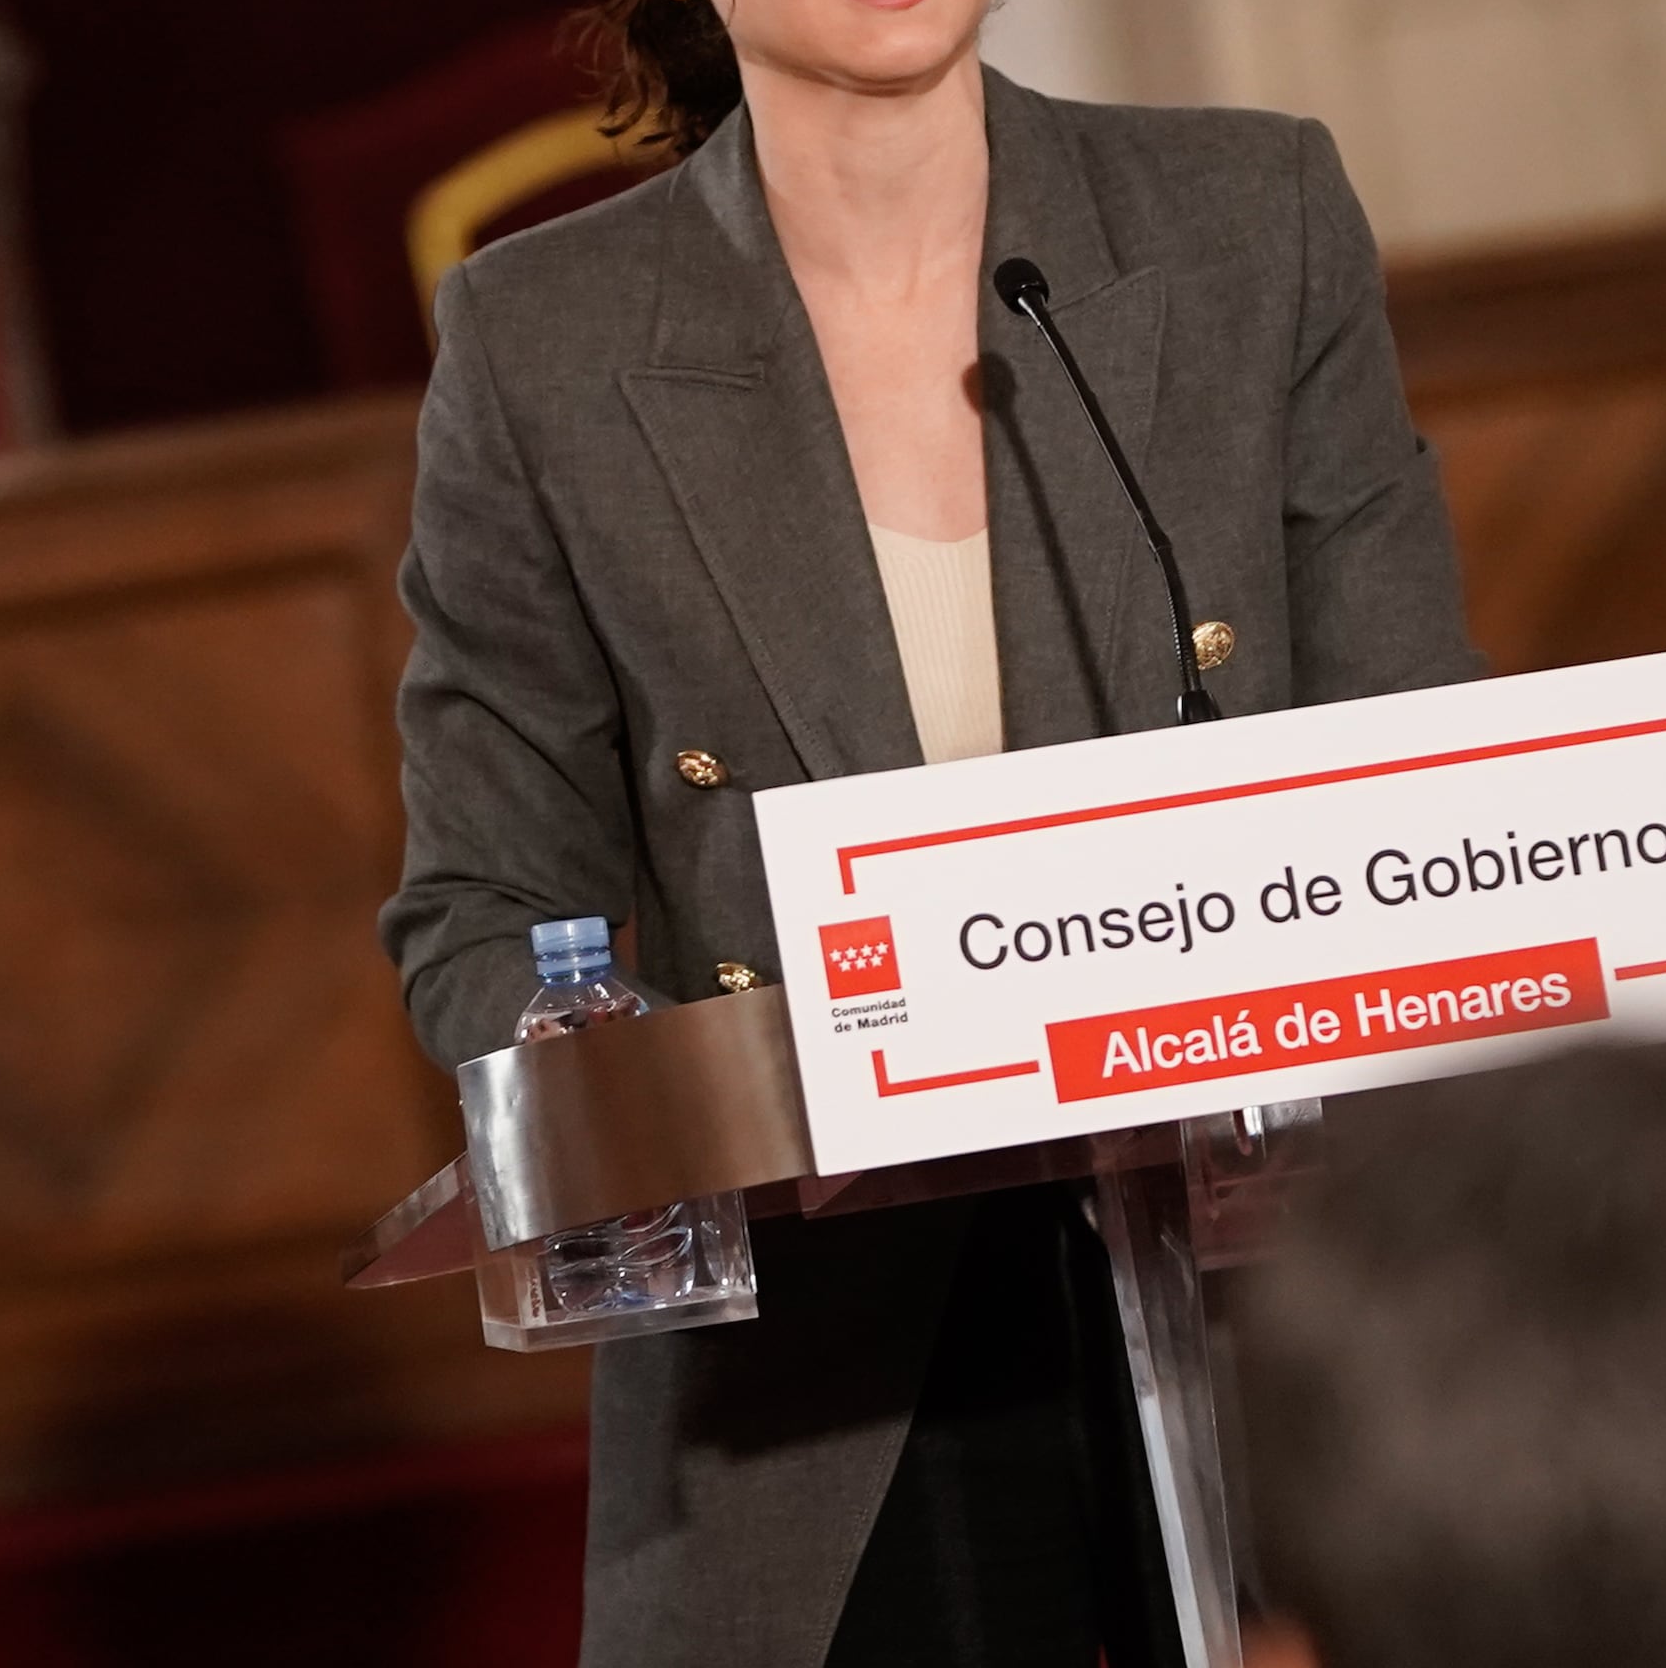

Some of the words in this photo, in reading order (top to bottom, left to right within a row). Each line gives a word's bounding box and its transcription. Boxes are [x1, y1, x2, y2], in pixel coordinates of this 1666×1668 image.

[959, 883, 1235, 970] Consejo
[1260, 866, 1342, 924] de
[831, 997, 906, 1018] Comunidad
[834, 1022, 852, 1033] de
[857, 1012, 909, 1029] Madrid
[1102, 1009, 1263, 1079] Alcalá
[1274, 1002, 1341, 1050] de
[1354, 972, 1572, 1037] Henares
